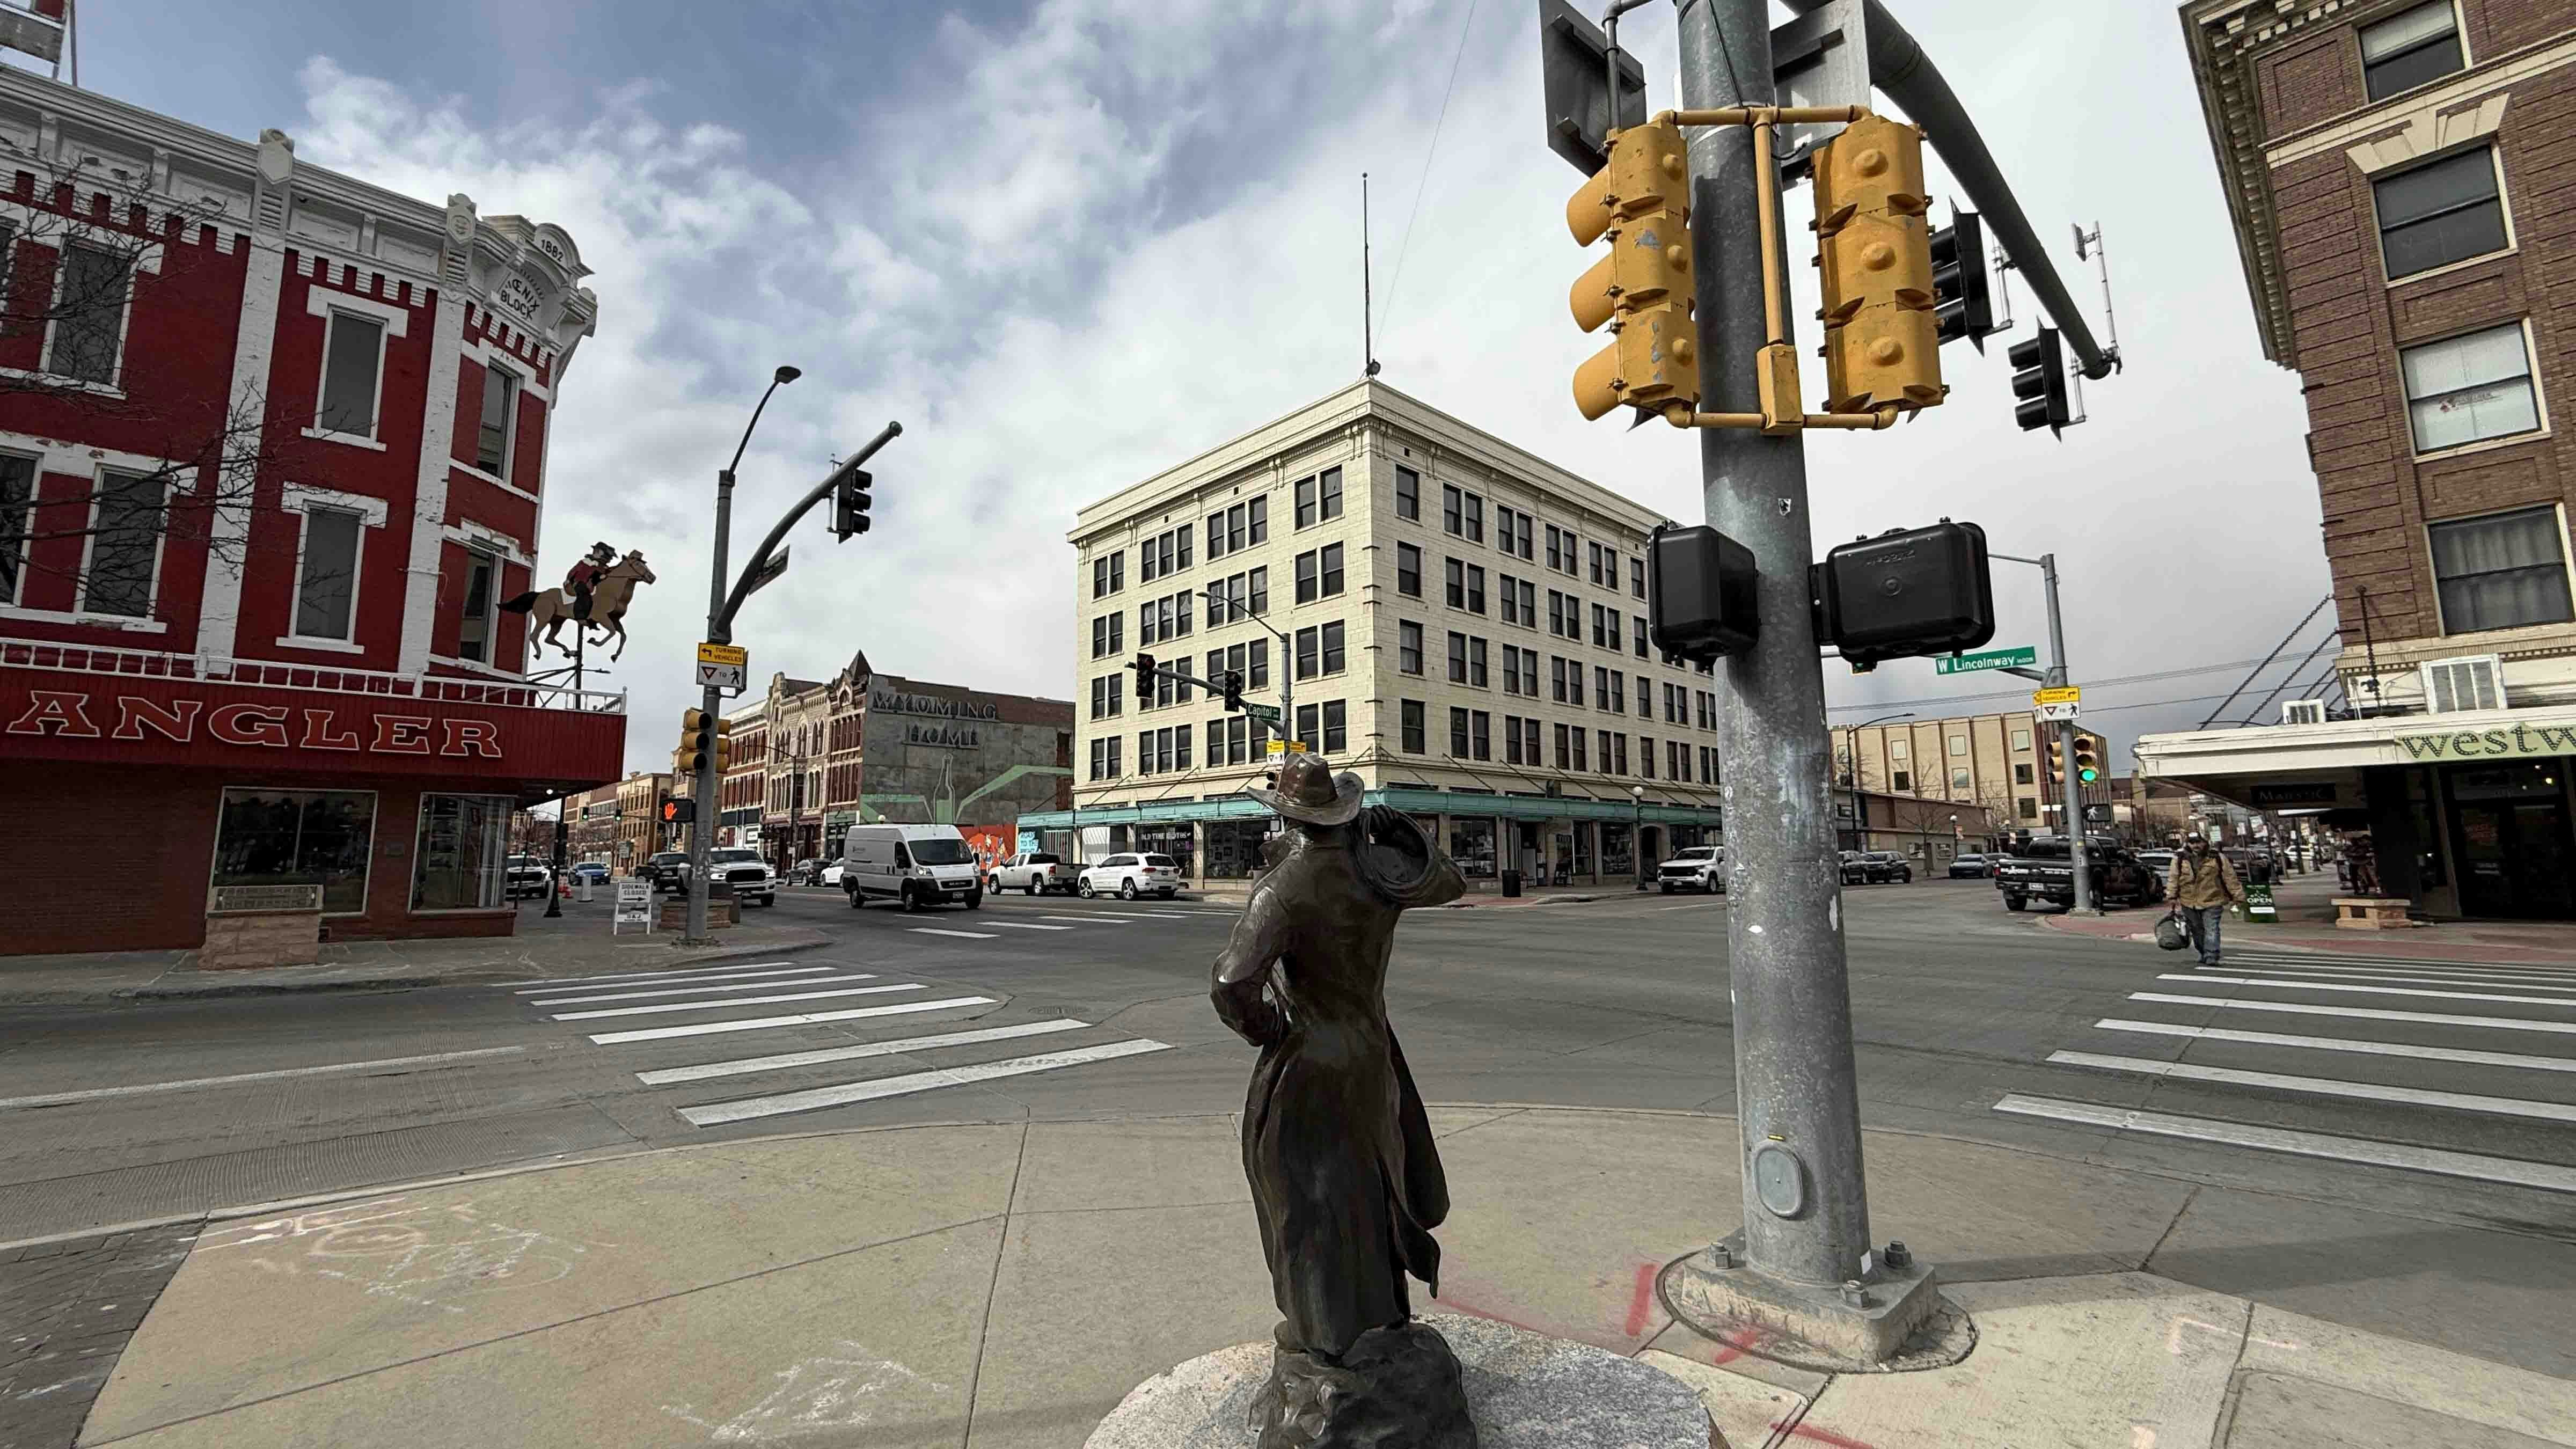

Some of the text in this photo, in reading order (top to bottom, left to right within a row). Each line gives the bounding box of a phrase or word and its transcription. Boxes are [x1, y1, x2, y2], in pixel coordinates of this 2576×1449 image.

[541, 239, 563, 262] 1882
[501, 290, 533, 320] BLOCK
[1937, 659, 1948, 672] W
[1953, 656, 2015, 671] Lincolnway
[872, 691, 997, 720] WYOMING
[1248, 704, 1272, 718] Capitol
[5, 691, 503, 757] ANGLER
